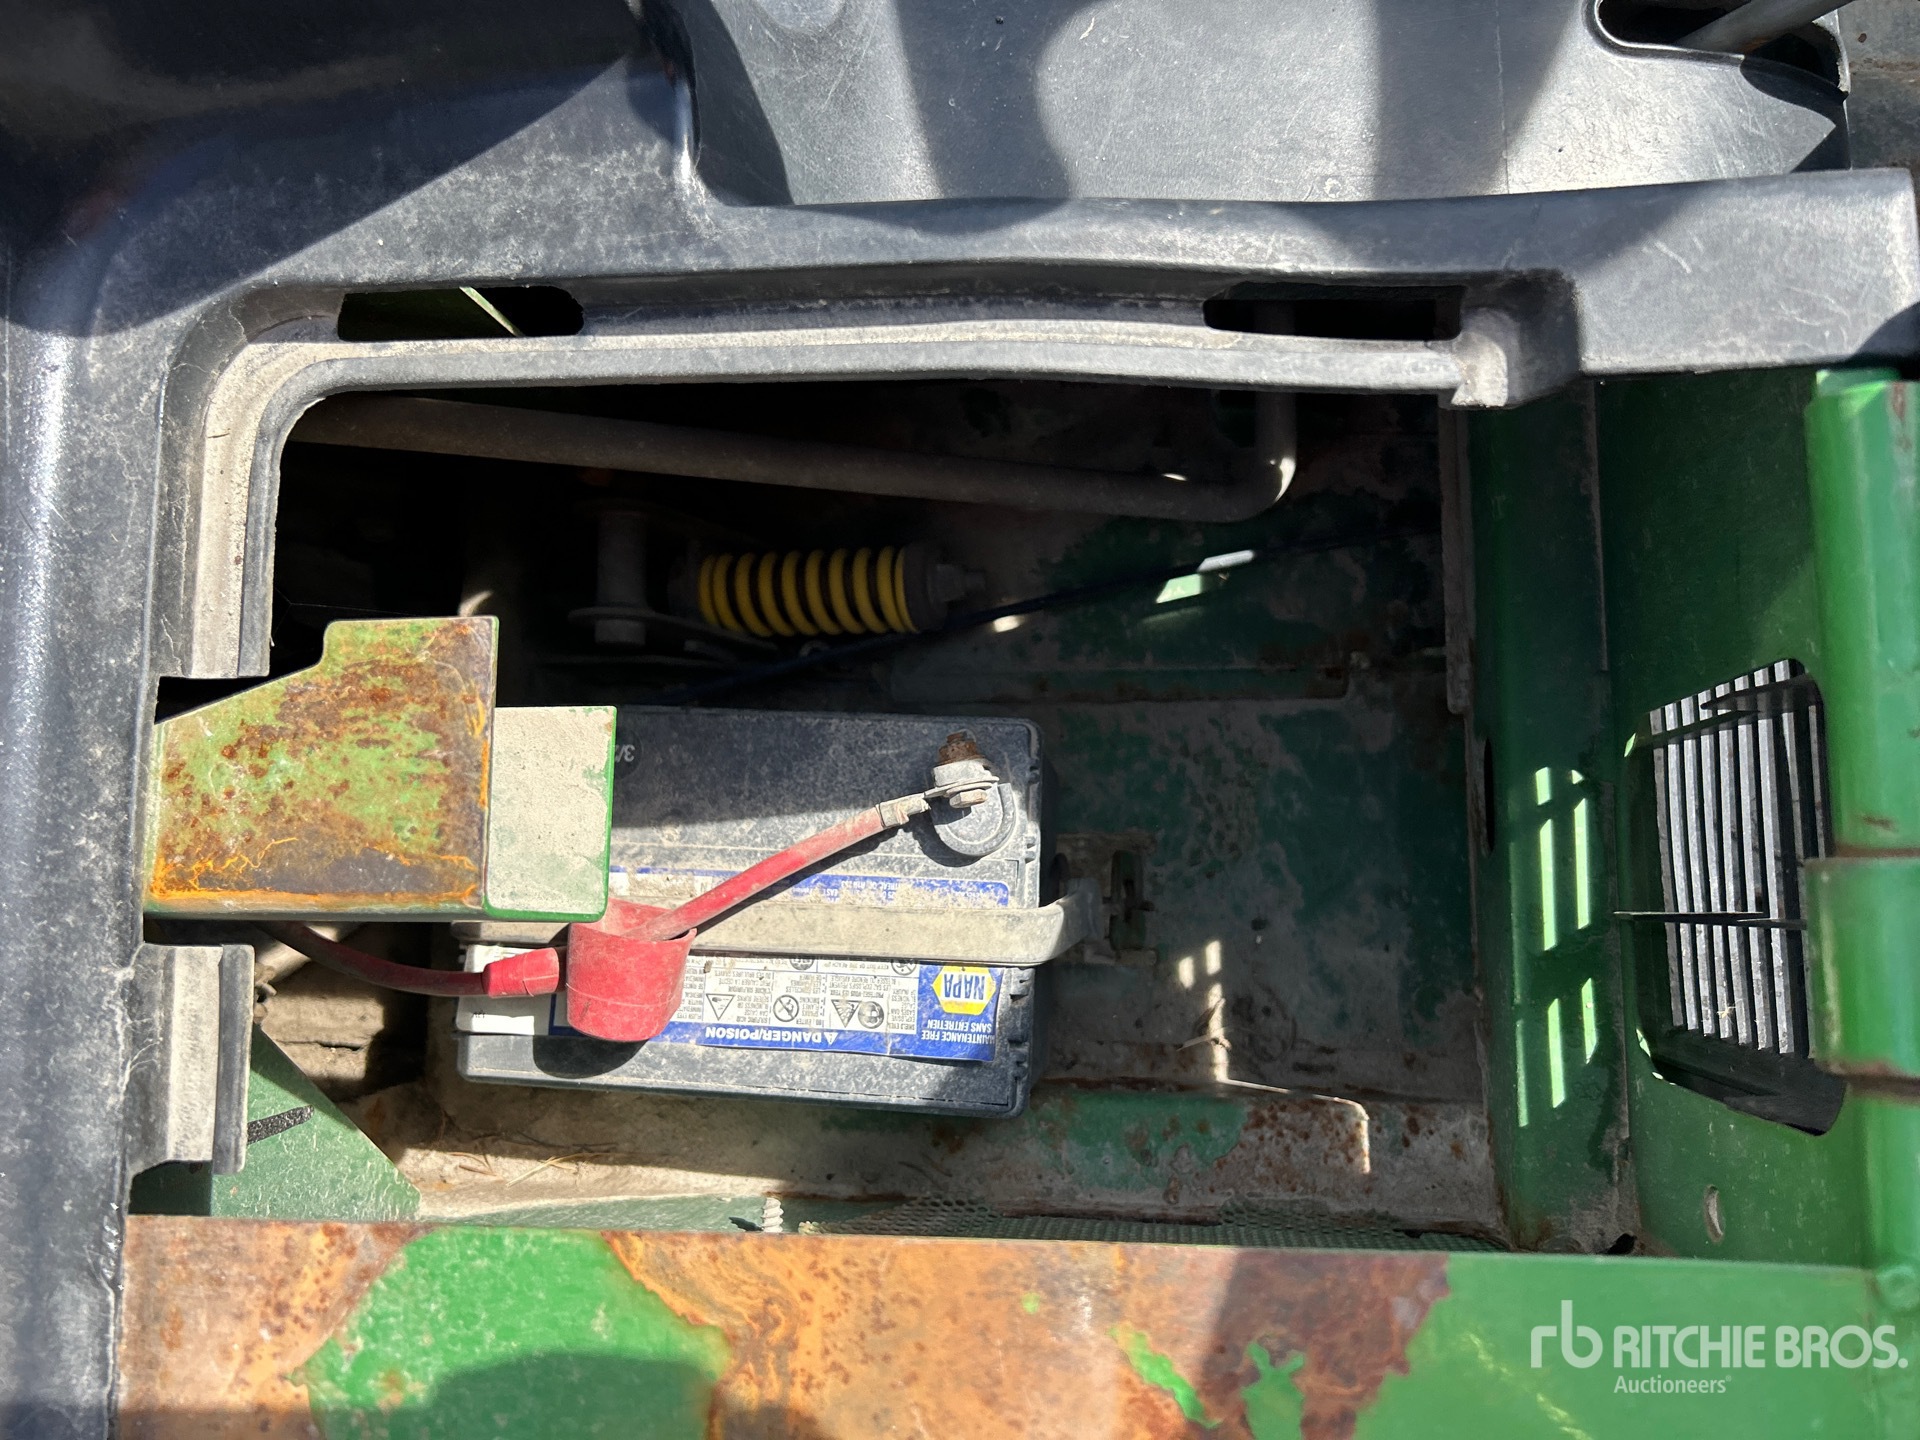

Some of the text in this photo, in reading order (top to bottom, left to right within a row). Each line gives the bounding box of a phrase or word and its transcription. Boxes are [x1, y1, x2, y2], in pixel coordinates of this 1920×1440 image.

[944, 974, 985, 1000] NAPA
[927, 1019, 992, 1033] SANS ENTRETIEN
[705, 1027, 822, 1043] DANGER/POISON
[921, 1030, 995, 1044] MAINTENANCE FREE
